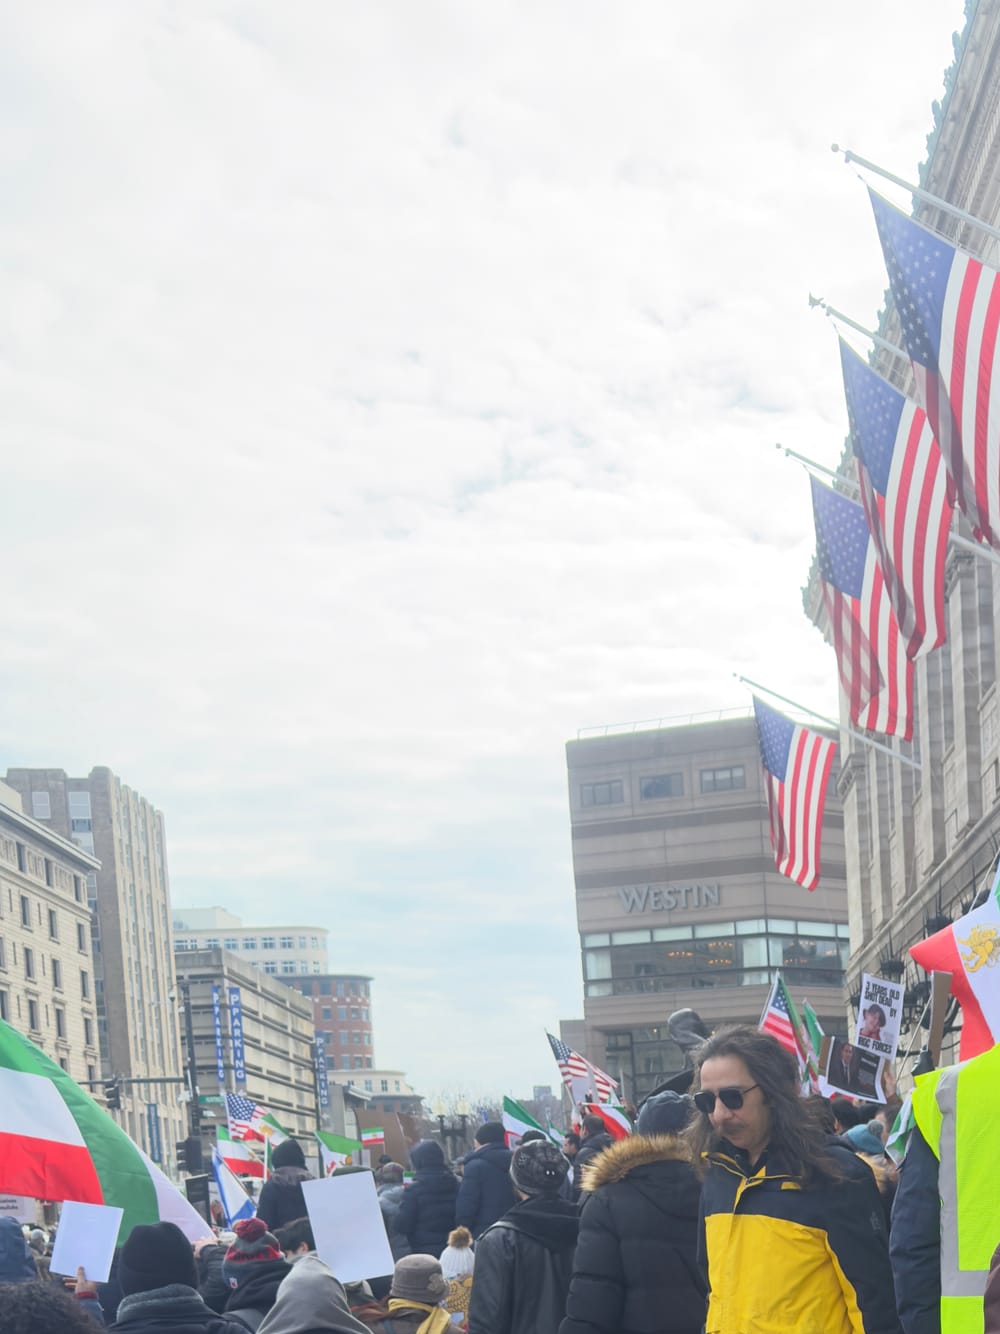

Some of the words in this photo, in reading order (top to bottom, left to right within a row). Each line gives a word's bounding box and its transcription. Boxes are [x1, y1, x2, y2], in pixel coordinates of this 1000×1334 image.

[618, 883, 720, 913] WESTIN
[864, 990, 878, 1004] SHOT
[879, 993, 893, 1007] DEAD
[872, 983, 888, 997] YEARS
[889, 989, 900, 1001] OLD
[890, 1007, 897, 1018] BY
